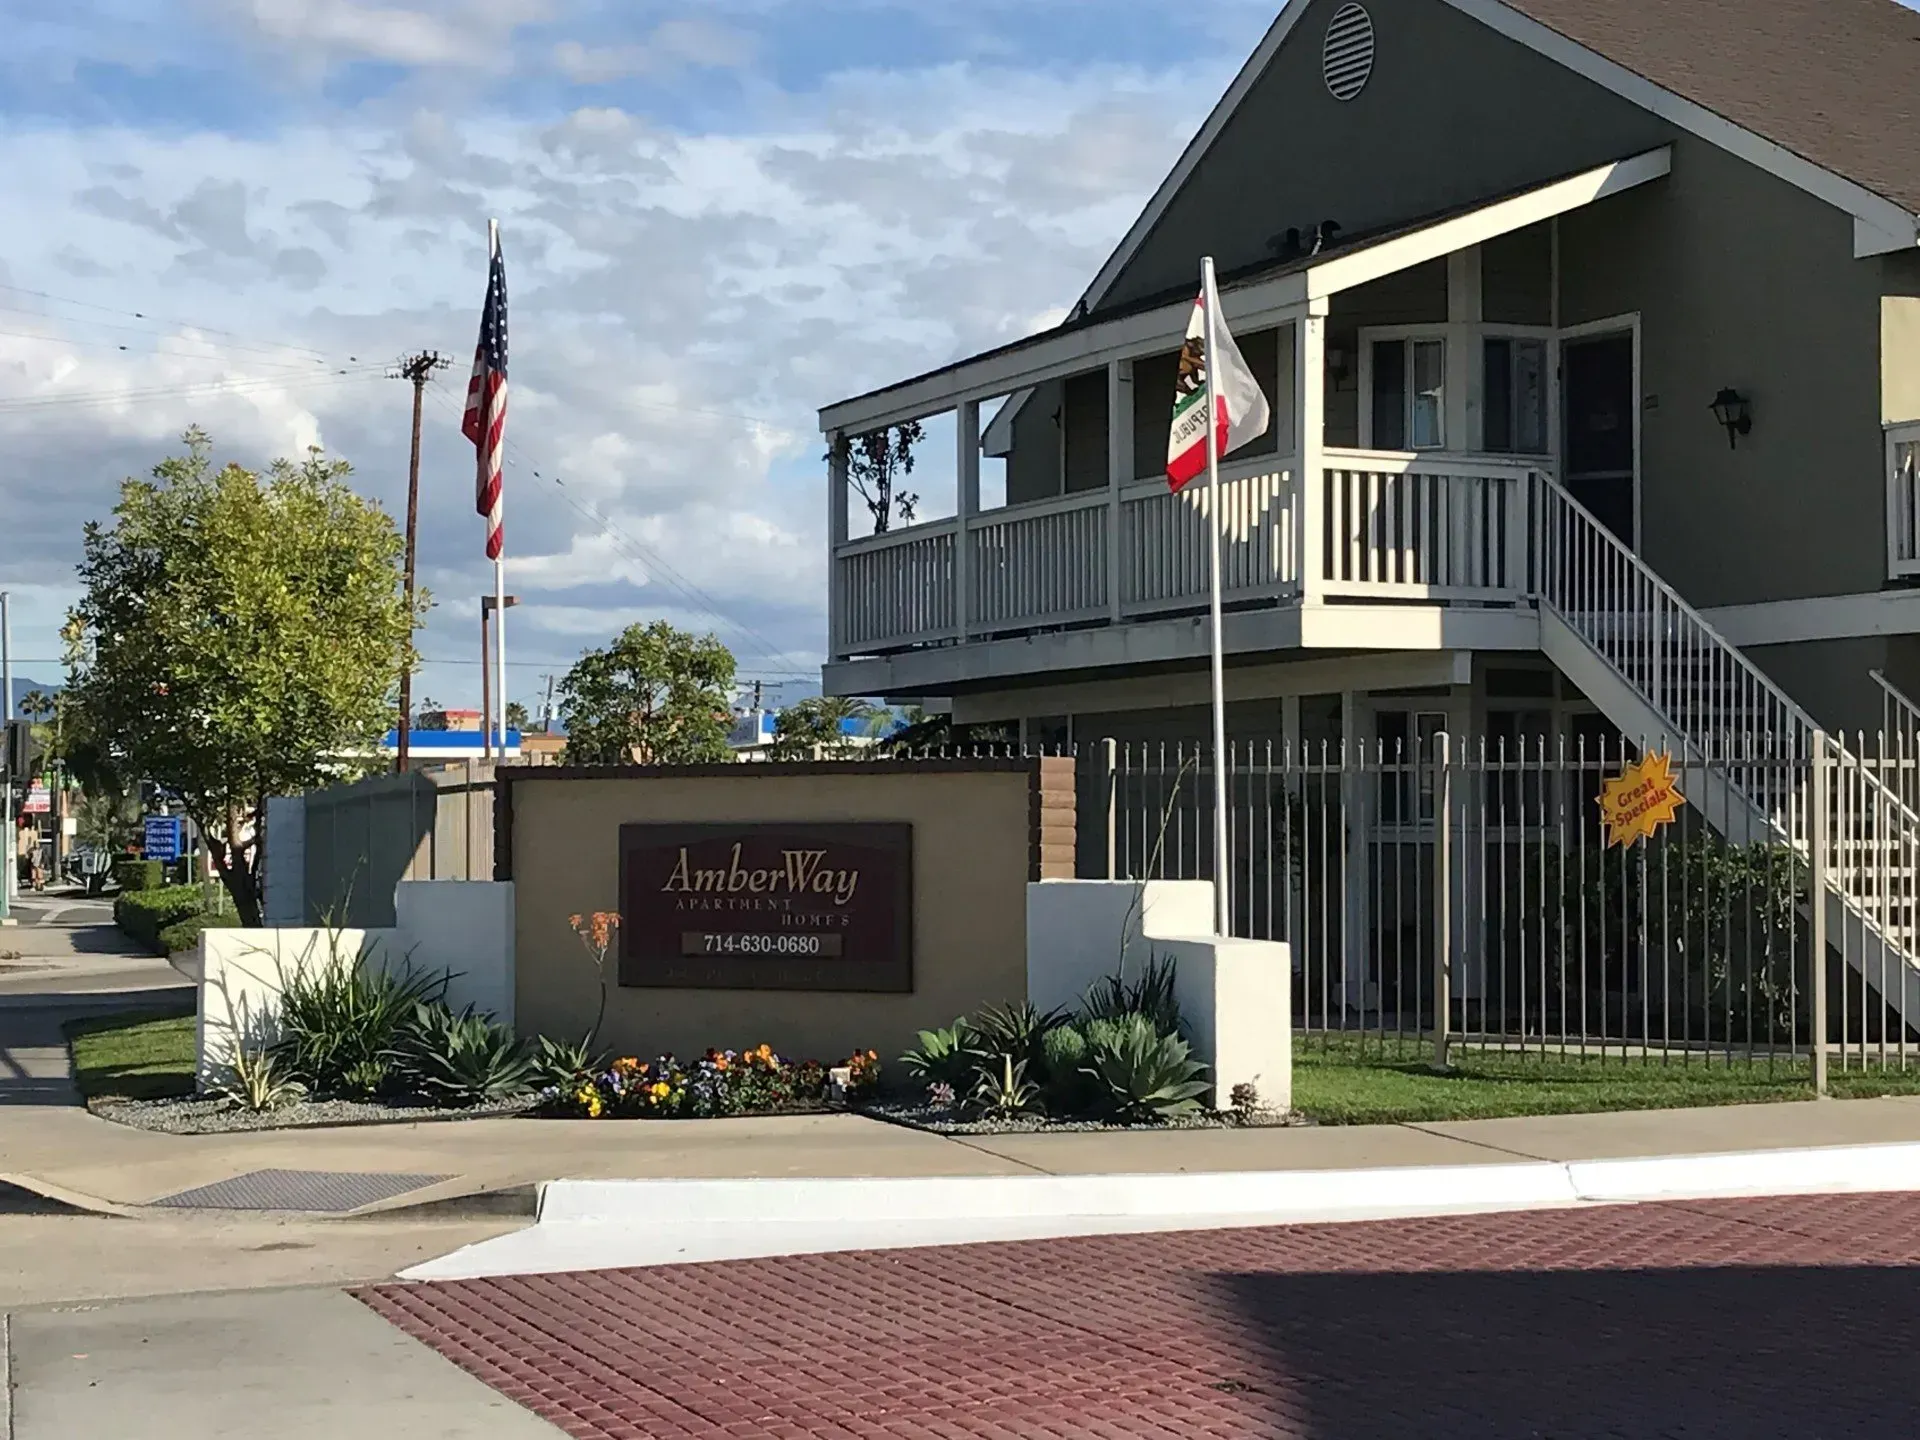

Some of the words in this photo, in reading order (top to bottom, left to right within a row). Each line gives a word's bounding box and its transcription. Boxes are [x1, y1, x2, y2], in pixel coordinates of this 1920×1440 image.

[1617, 777, 1655, 807] Great
[1615, 788, 1668, 827] Specials
[661, 842, 859, 904] AmberWay
[675, 898, 793, 911] APARTMENT
[781, 914, 851, 926] HOMES
[703, 934, 820, 954] 714-630-0680
